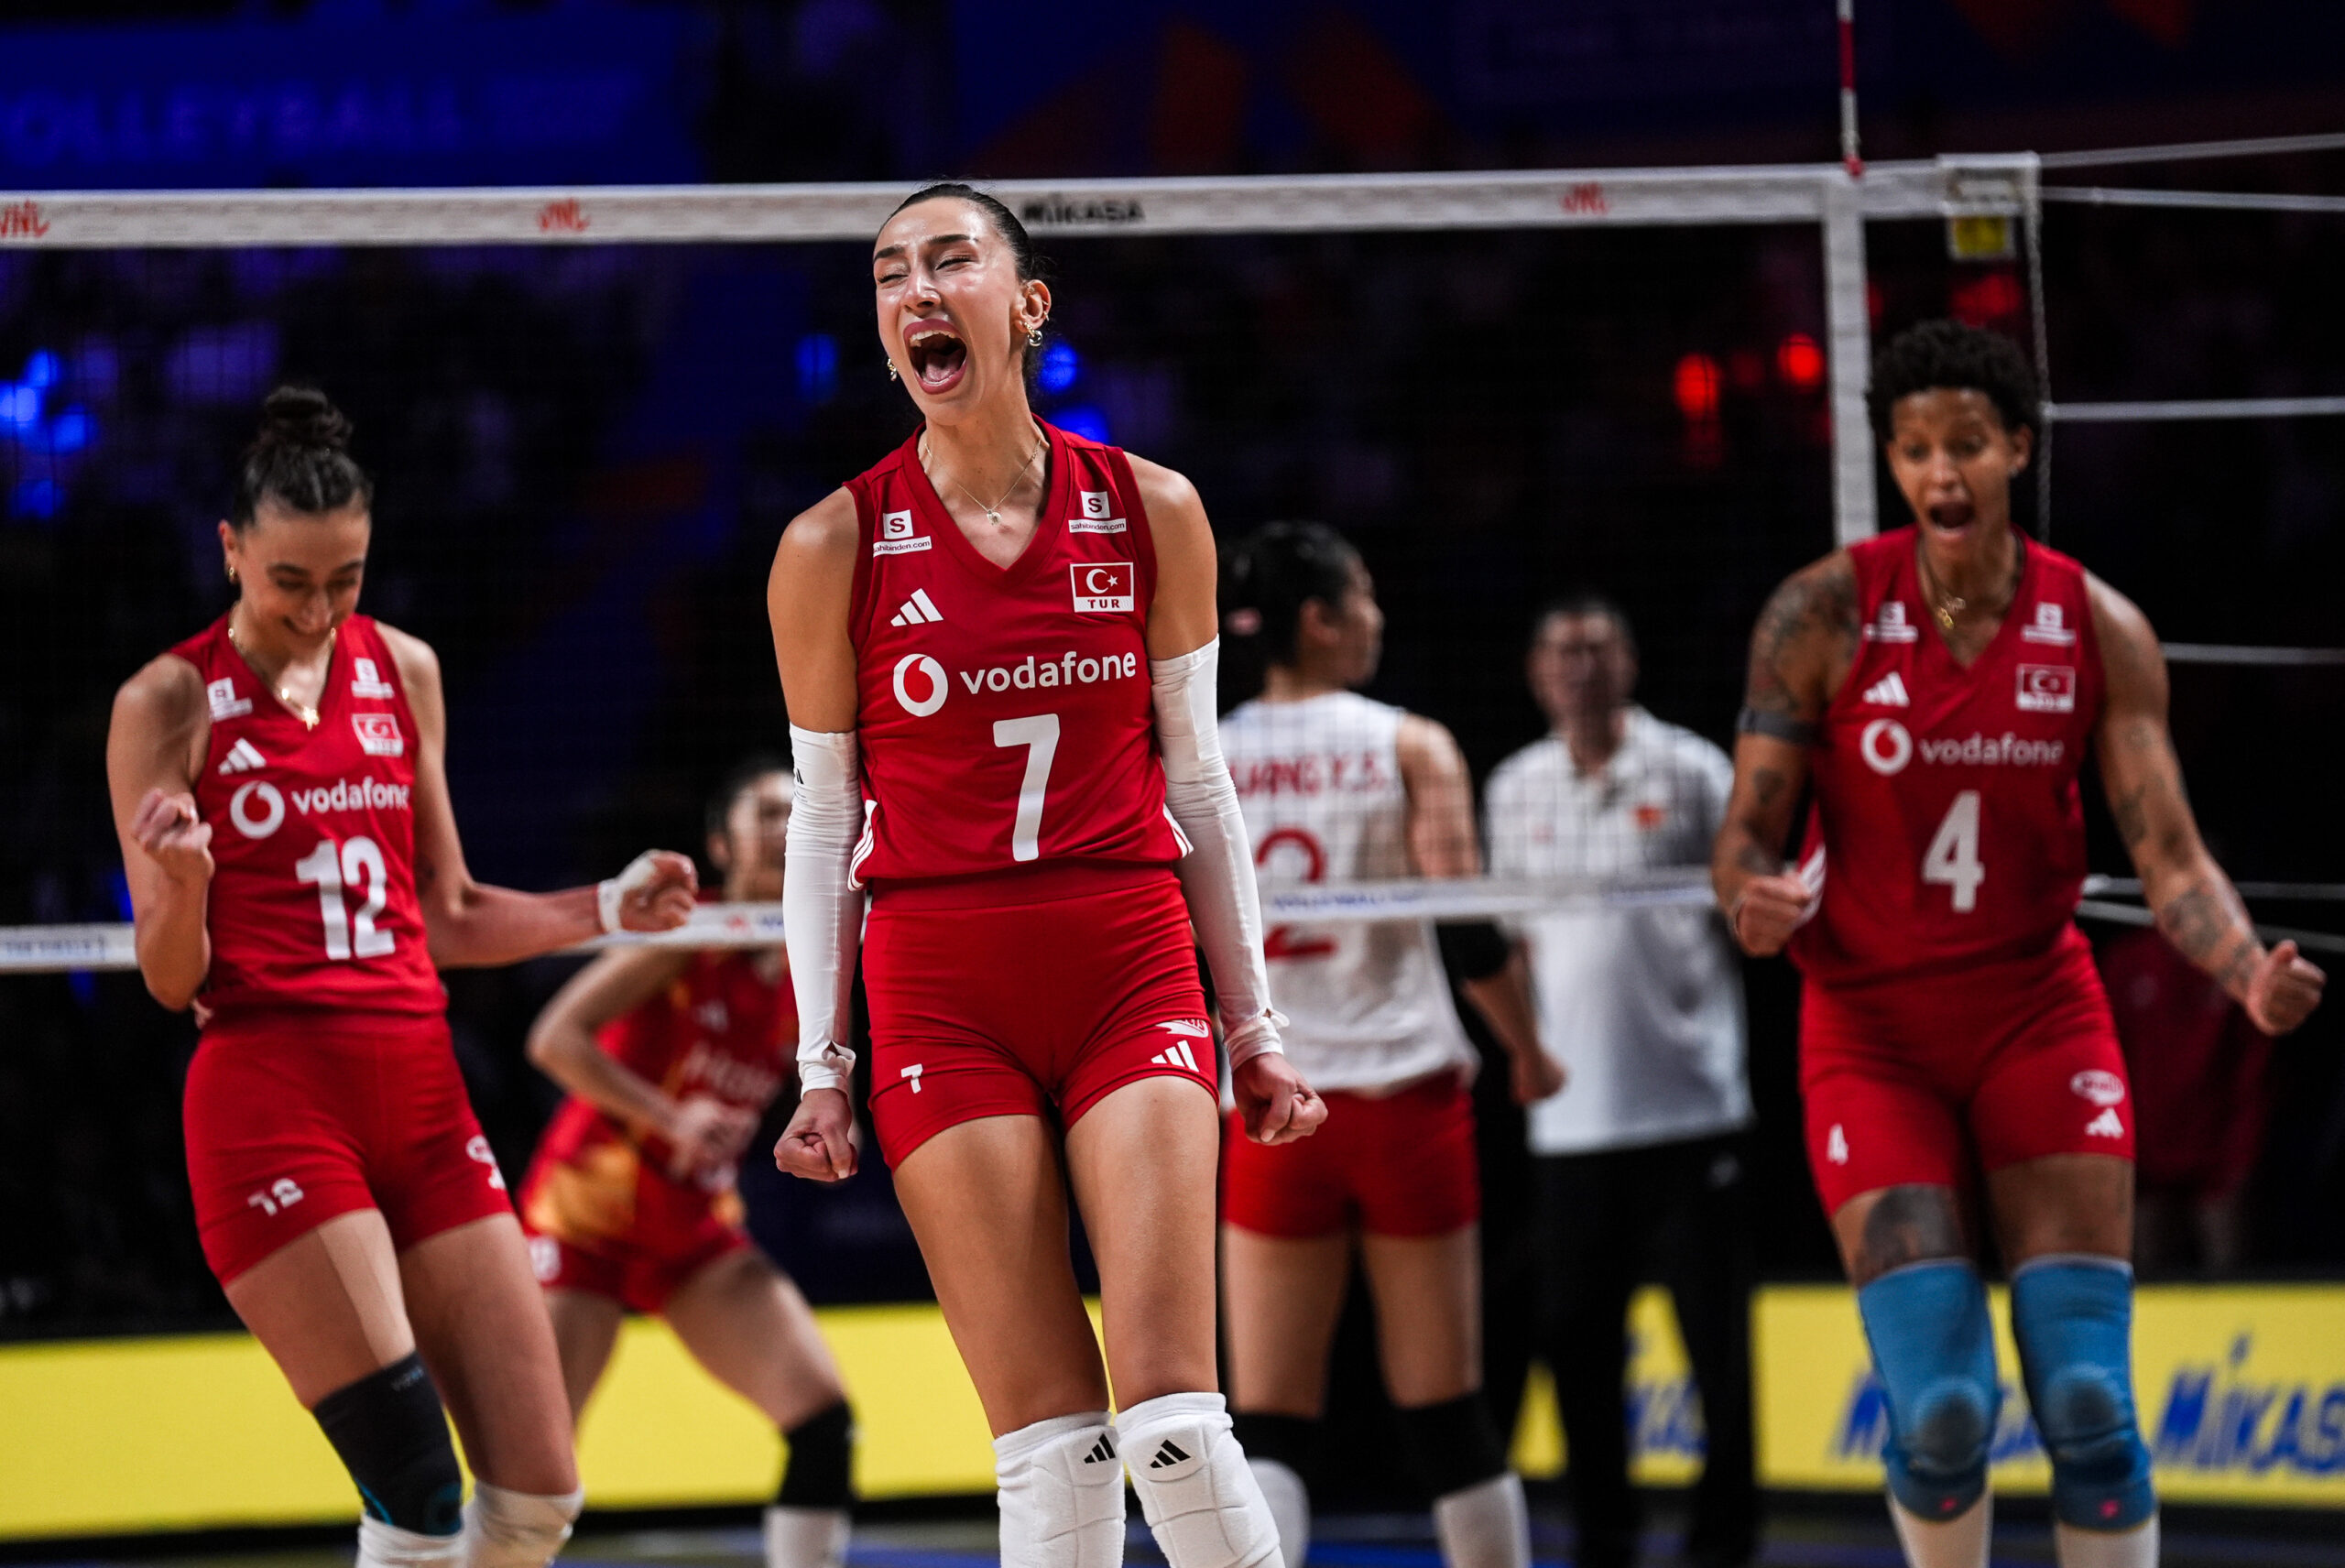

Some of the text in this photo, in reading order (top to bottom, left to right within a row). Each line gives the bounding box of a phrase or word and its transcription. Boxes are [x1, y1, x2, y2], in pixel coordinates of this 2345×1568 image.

[0, 79, 464, 165] OLLEYBALL
[889, 517, 906, 533] S
[1087, 497, 1103, 513] S
[1086, 598, 1121, 610] TUR
[959, 650, 1137, 695] vodafone
[992, 713, 1061, 862] 7
[1921, 789, 1986, 914] 4
[295, 834, 397, 961] 12
[900, 1063, 923, 1094] 7
